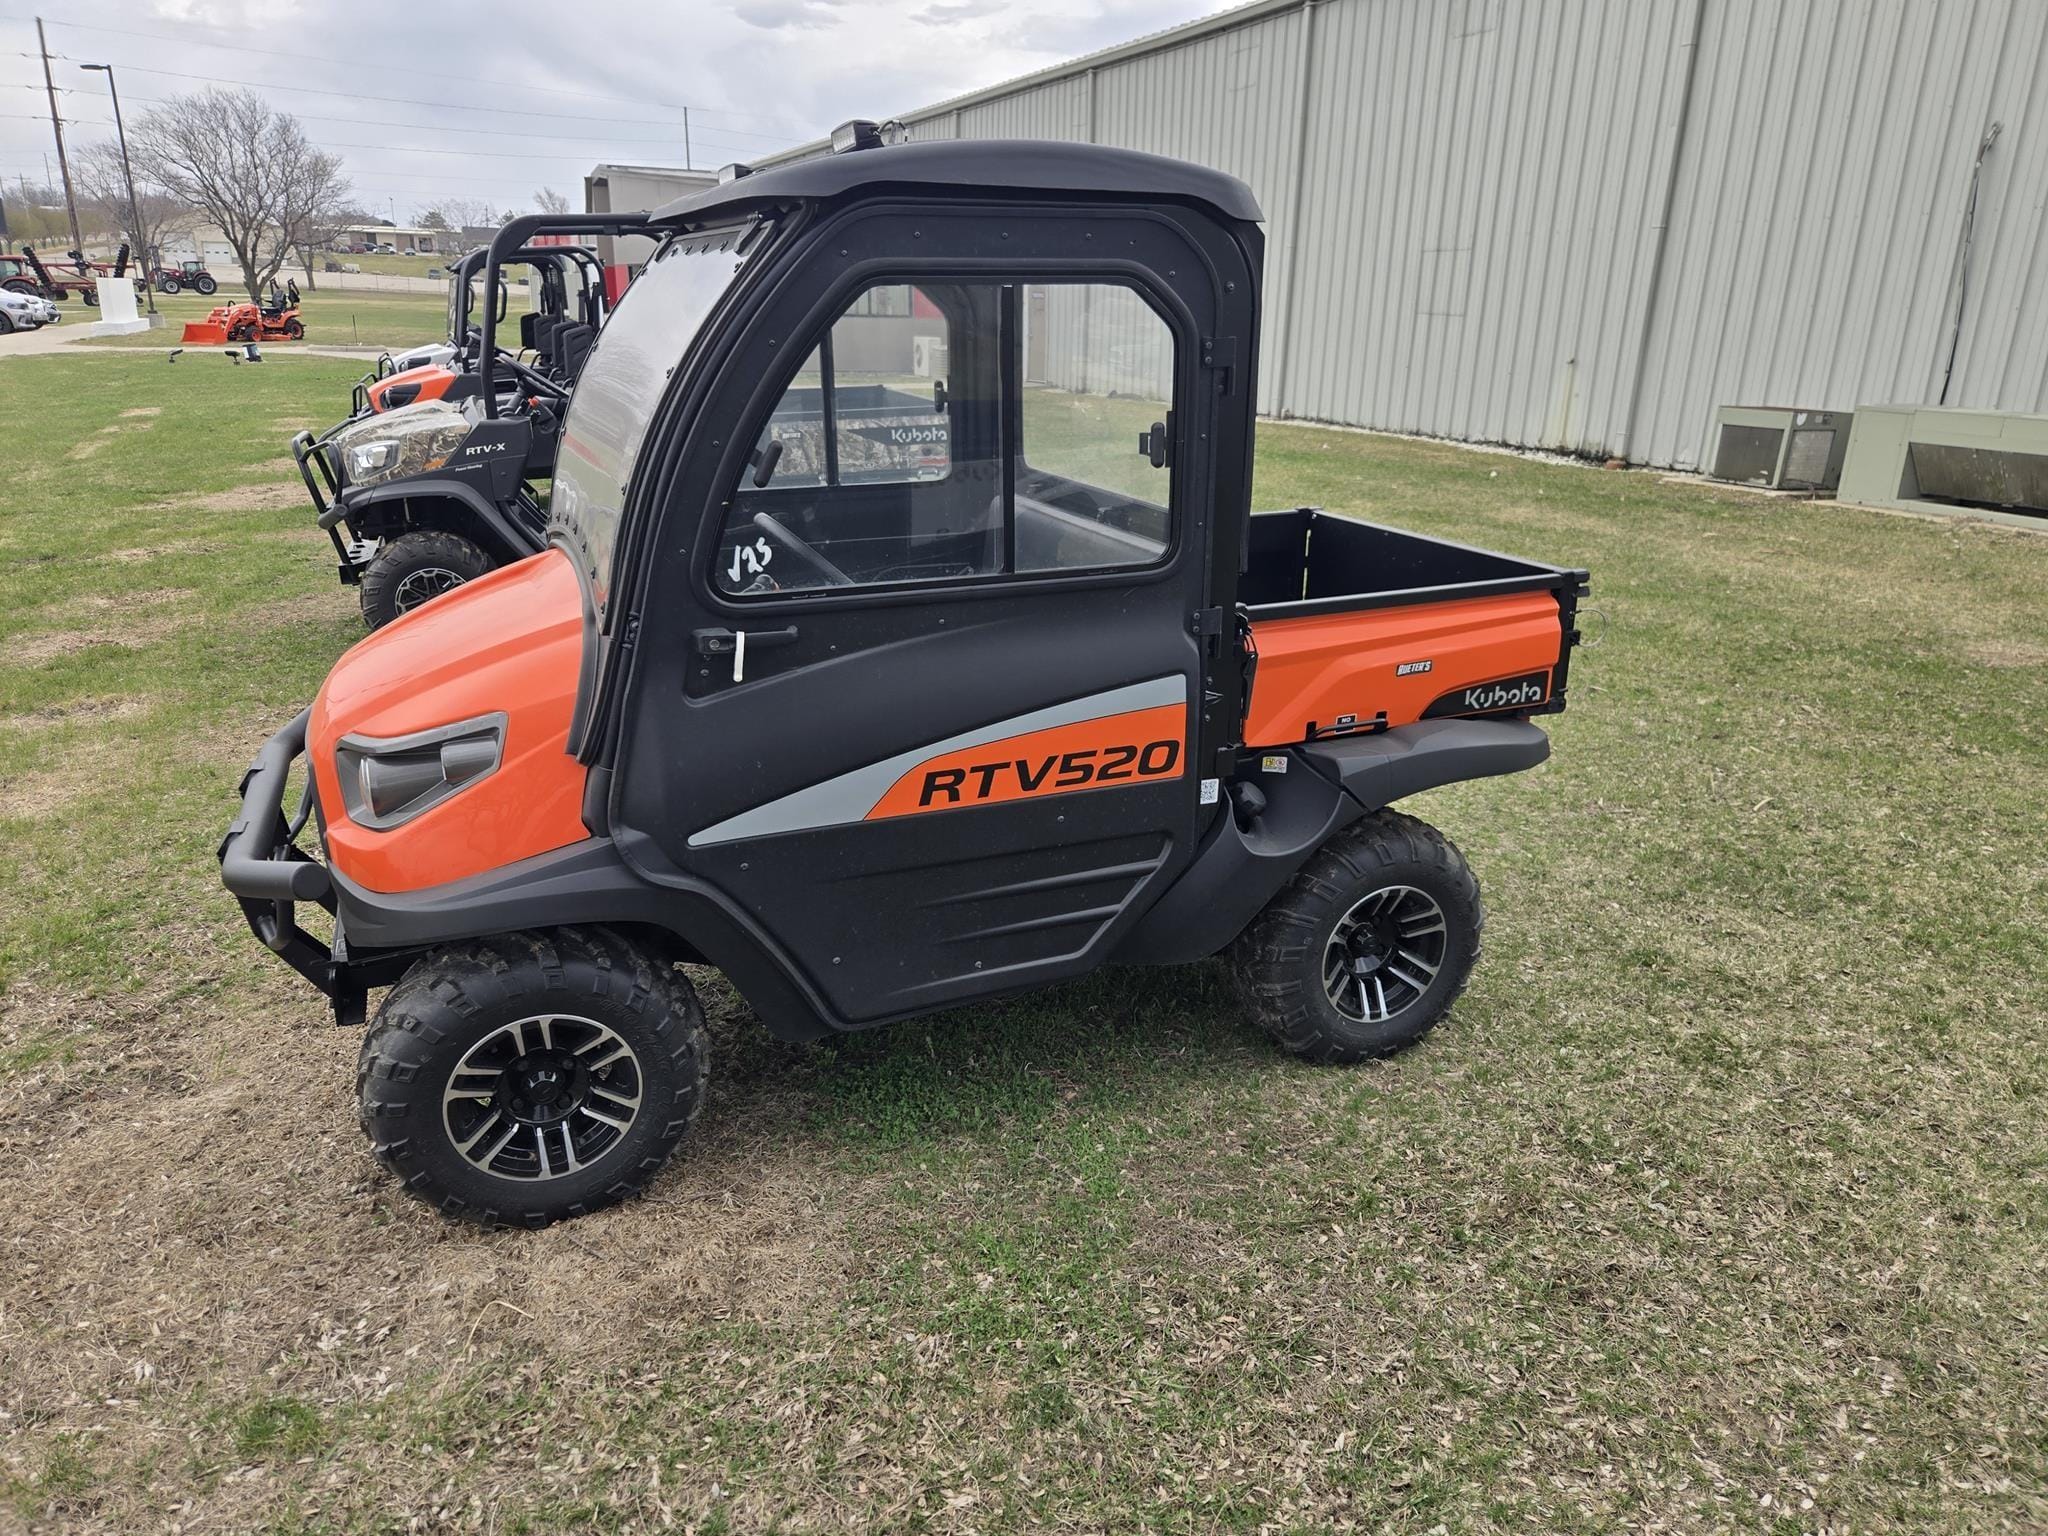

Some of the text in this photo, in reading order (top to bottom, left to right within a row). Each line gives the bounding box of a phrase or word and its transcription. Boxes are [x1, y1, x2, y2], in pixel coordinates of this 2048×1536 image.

[891, 427, 948, 443] Kubota
[466, 442, 506, 456] RTV-X
[1465, 682, 1541, 709] Kubota
[918, 739, 1180, 807] RTV520
